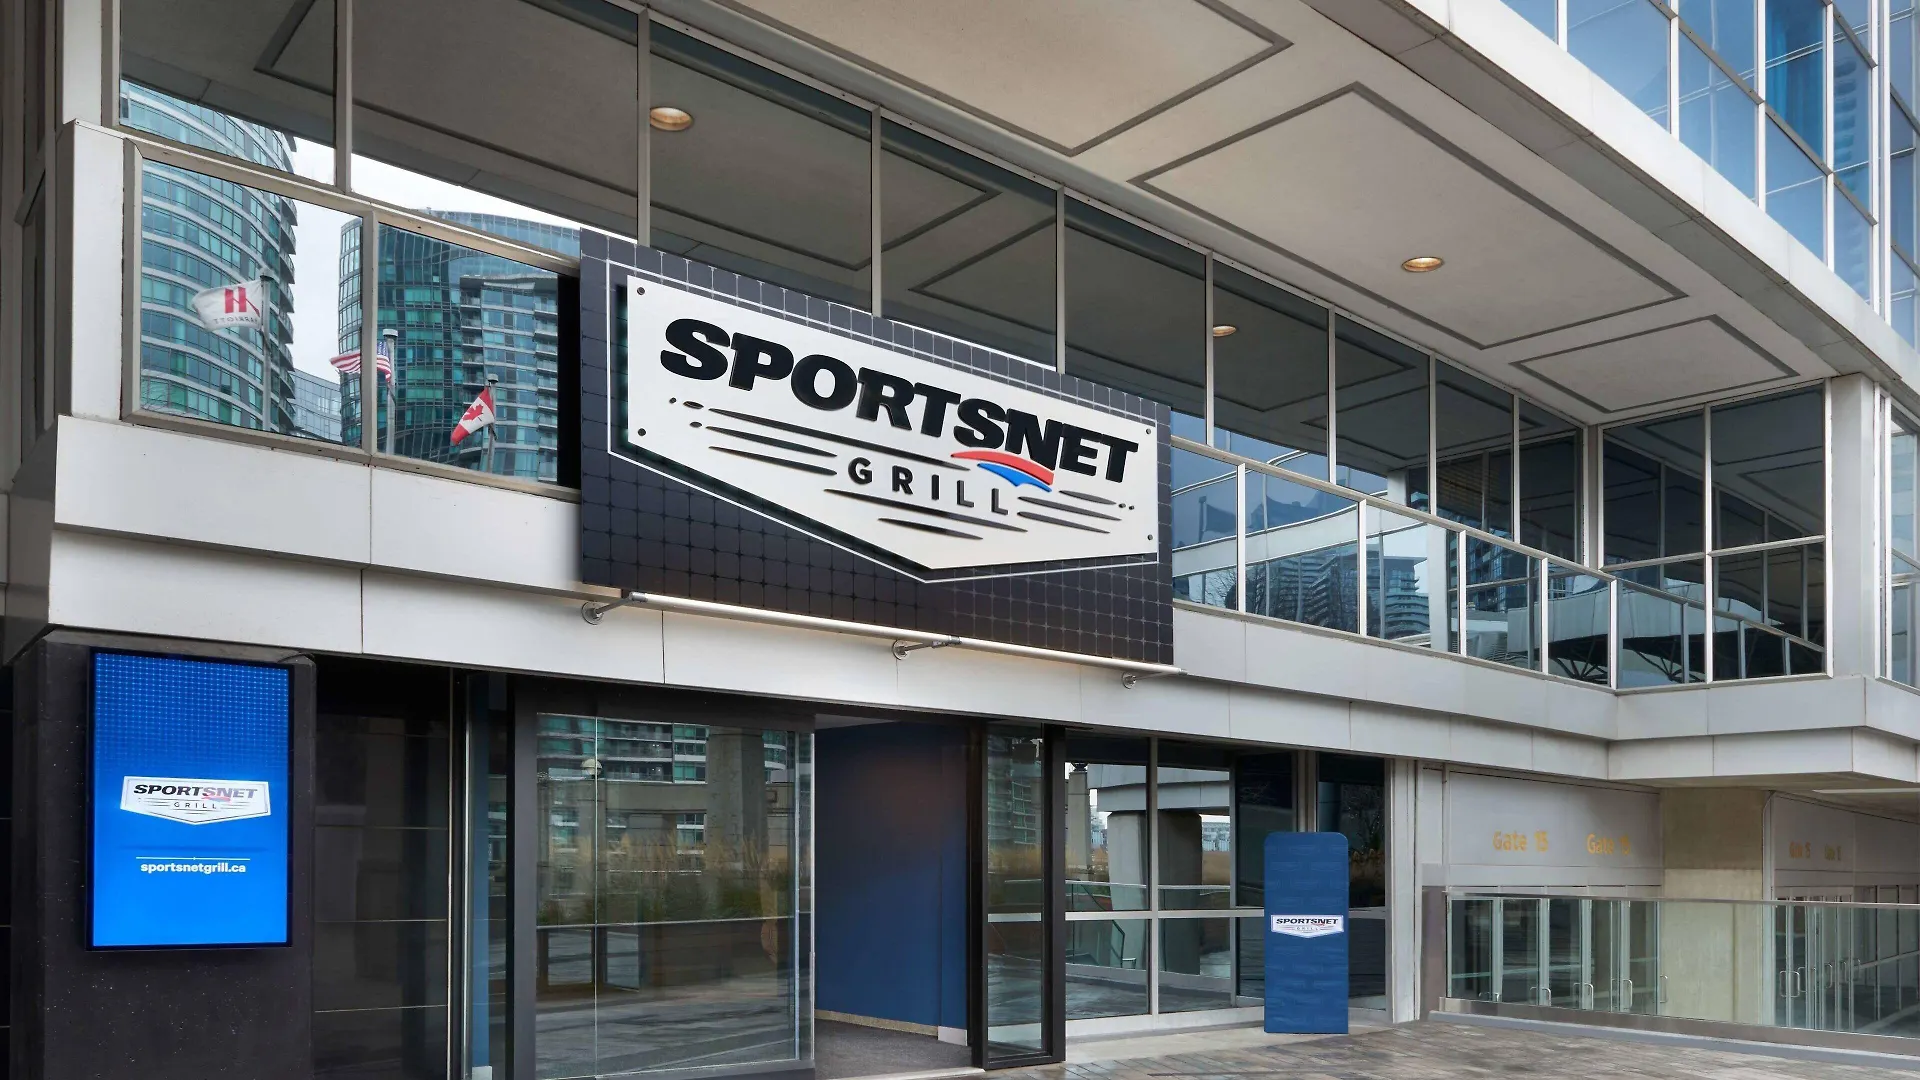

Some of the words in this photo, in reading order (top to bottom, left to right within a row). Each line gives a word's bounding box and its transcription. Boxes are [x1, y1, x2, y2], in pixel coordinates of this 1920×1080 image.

[660, 318, 1139, 484] SPORTSNET
[848, 457, 1009, 516] GRILL
[133, 784, 258, 799] SPORTSNET
[173, 801, 217, 810] GRILL
[1493, 831, 1527, 852] Gate
[140, 862, 246, 874] sportsnetgrill.ca
